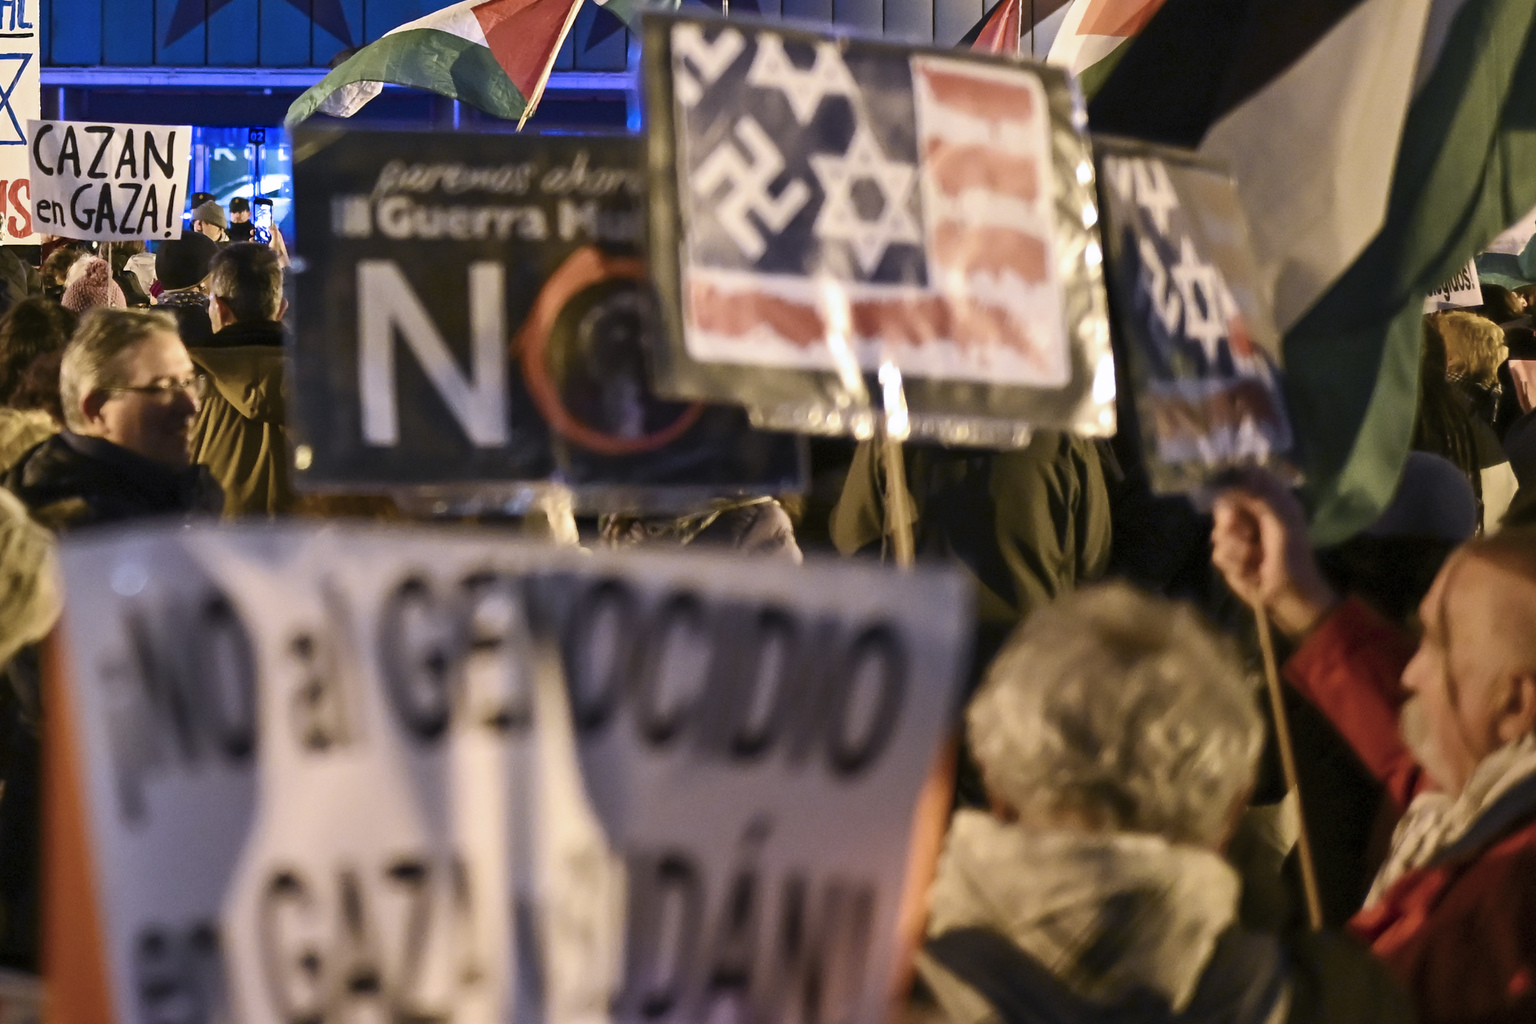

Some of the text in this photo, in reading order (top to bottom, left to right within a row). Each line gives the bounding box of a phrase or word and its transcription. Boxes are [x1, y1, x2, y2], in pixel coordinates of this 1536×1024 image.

[33, 124, 176, 180] CAZAN
[36, 182, 177, 238] en GAZA!
